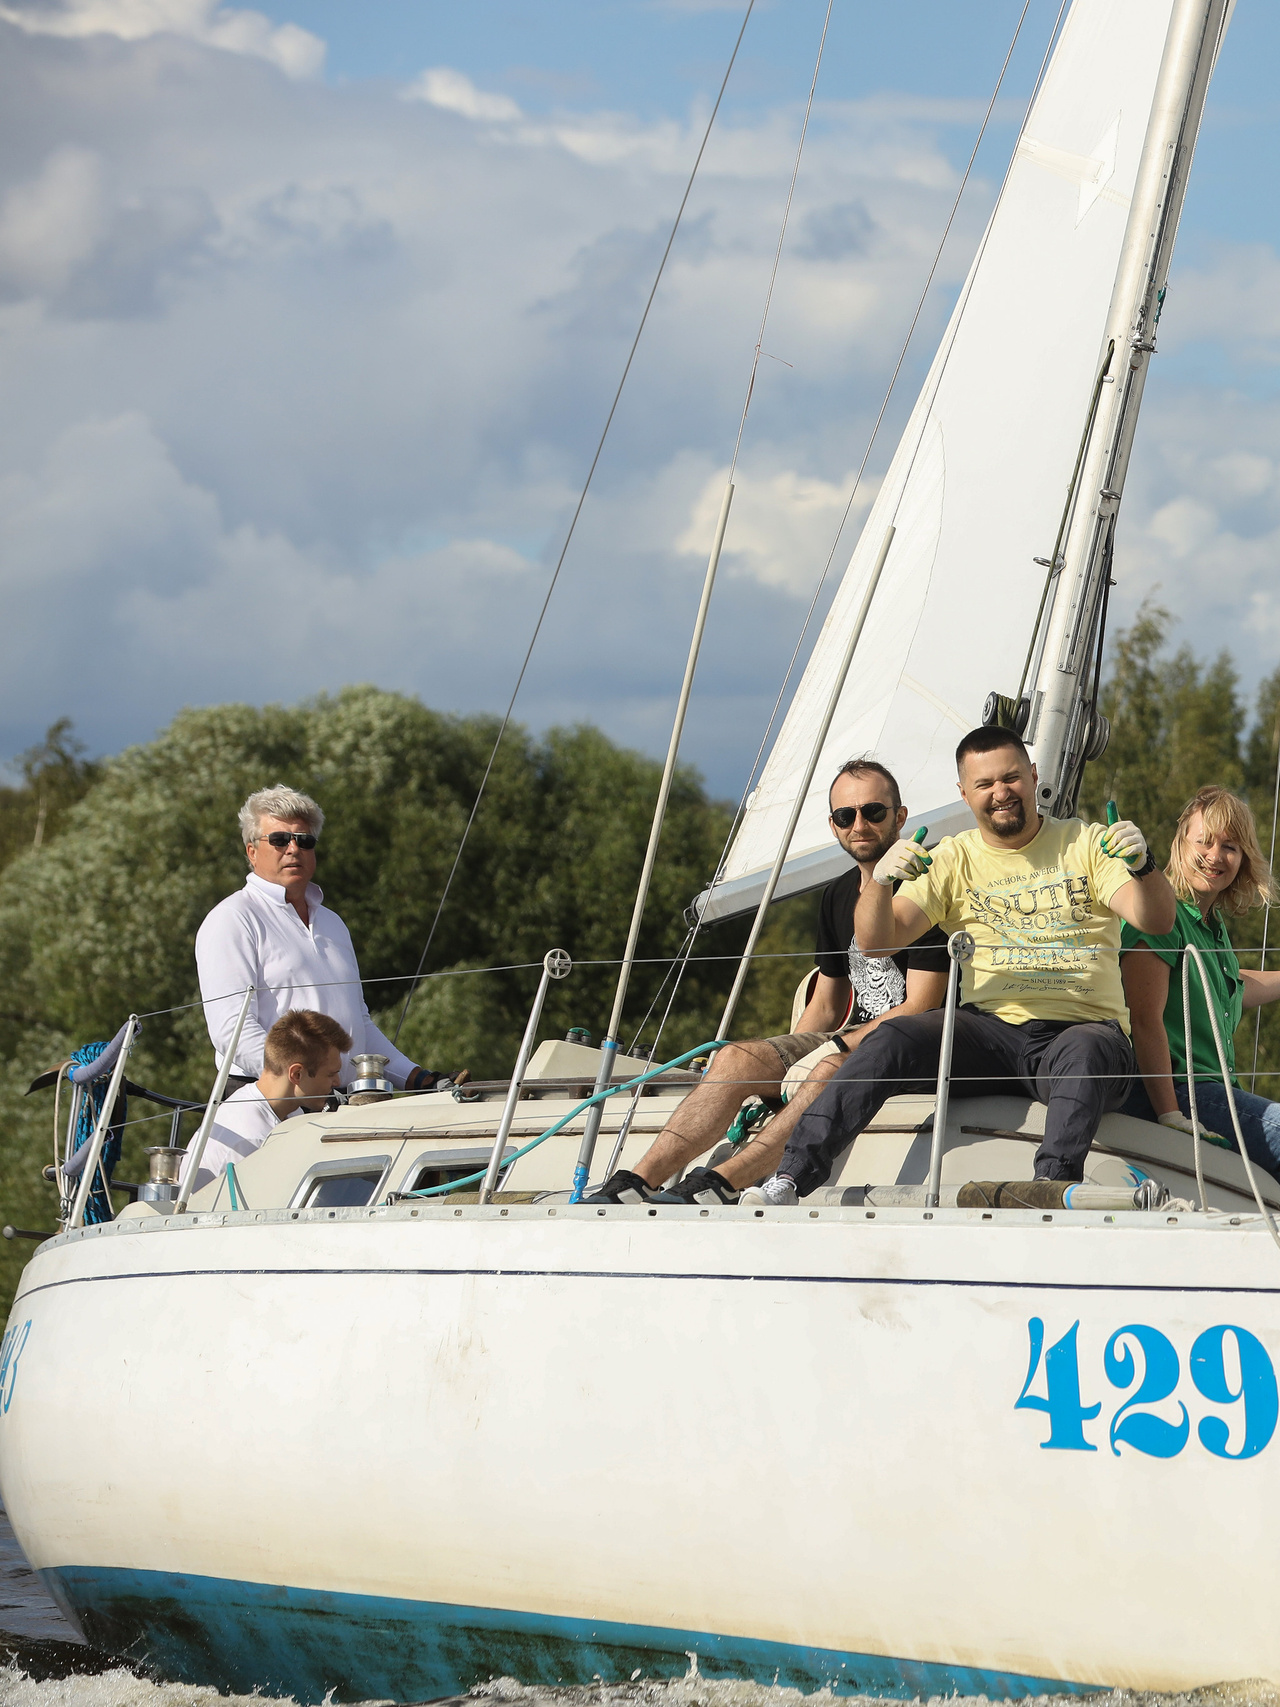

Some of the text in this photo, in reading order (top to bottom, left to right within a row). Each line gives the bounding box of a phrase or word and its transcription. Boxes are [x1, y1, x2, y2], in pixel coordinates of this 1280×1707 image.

[965, 875, 1093, 916] SOUTH
[987, 875, 1027, 888] ANCHORS
[1013, 1316, 1280, 1460] 429
